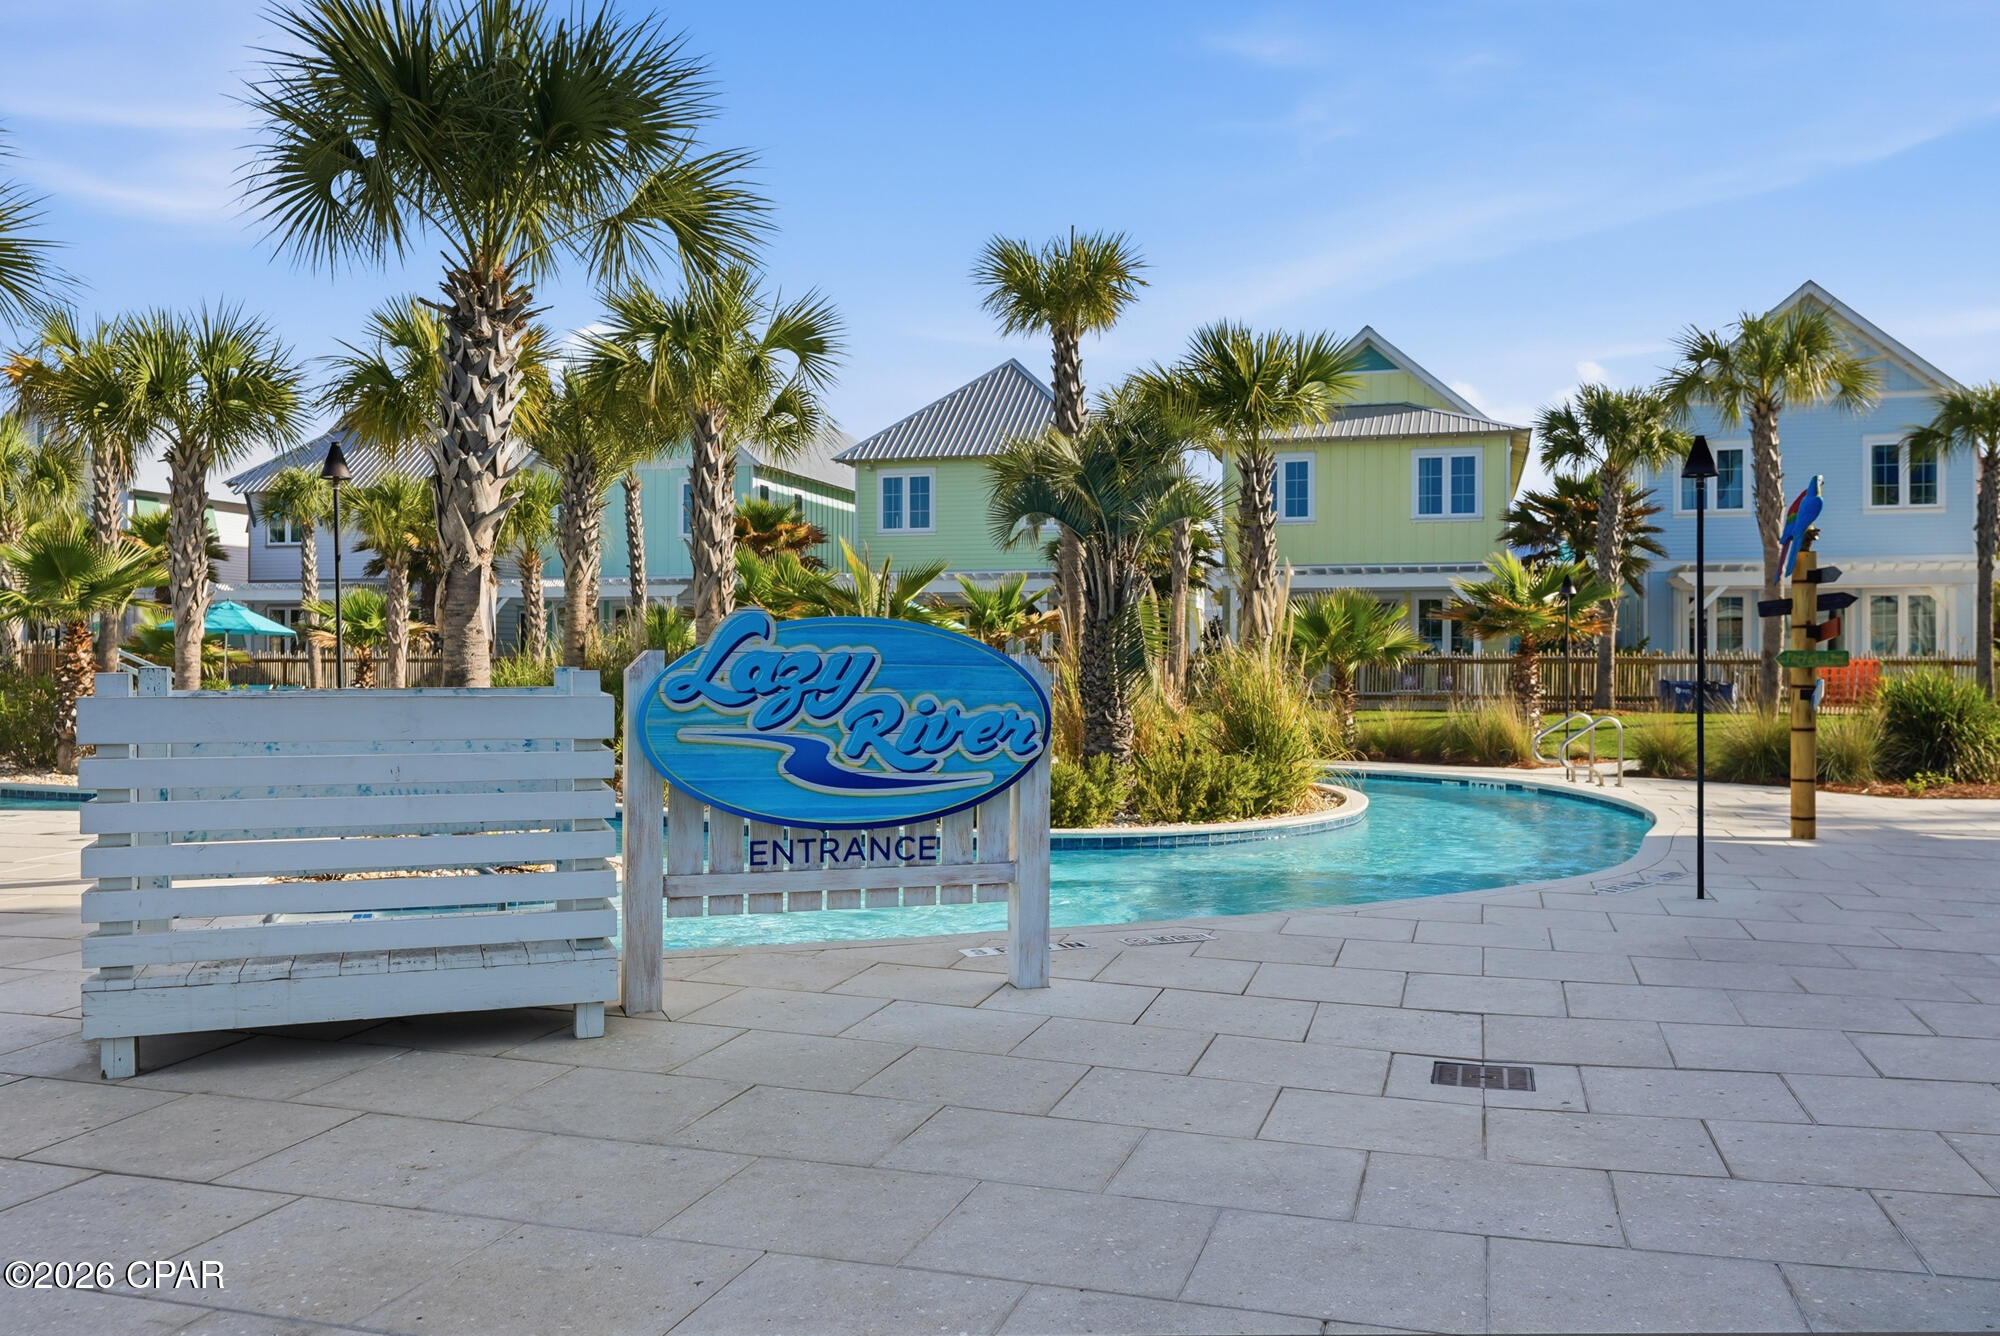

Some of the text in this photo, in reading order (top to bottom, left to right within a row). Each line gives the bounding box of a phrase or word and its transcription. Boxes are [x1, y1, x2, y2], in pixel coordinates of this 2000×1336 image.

[665, 610, 877, 732] Lazy
[844, 695, 1039, 773] River
[749, 836, 938, 866] ENTRANCE
